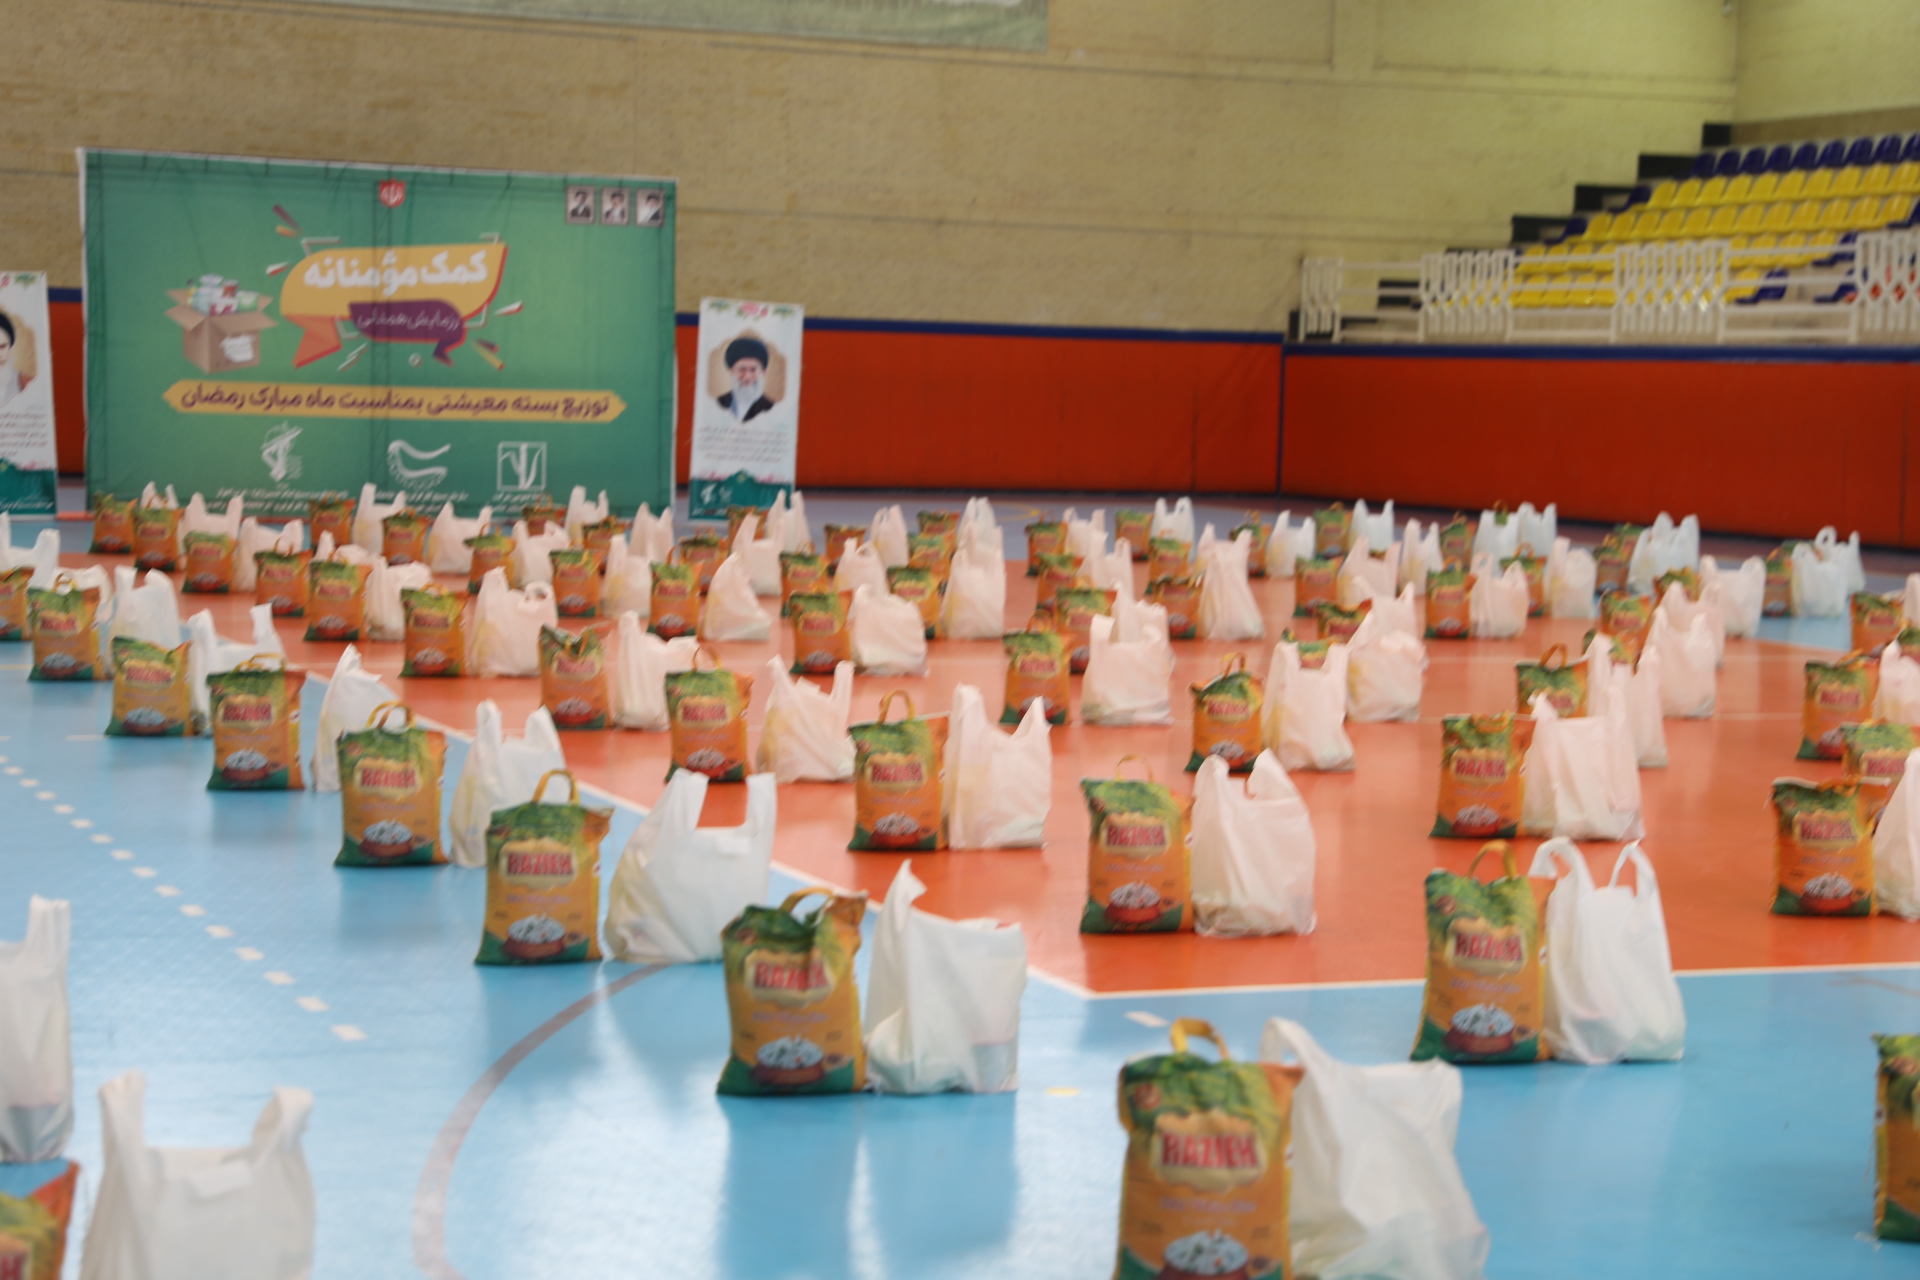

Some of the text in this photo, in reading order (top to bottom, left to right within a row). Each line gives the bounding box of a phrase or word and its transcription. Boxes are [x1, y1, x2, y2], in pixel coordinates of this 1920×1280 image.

[303, 248, 488, 297] کمک مؤمنانه
[181, 382, 610, 418] توزیع بسته معیشتی بمناسبت ماه مبارک رمضان
